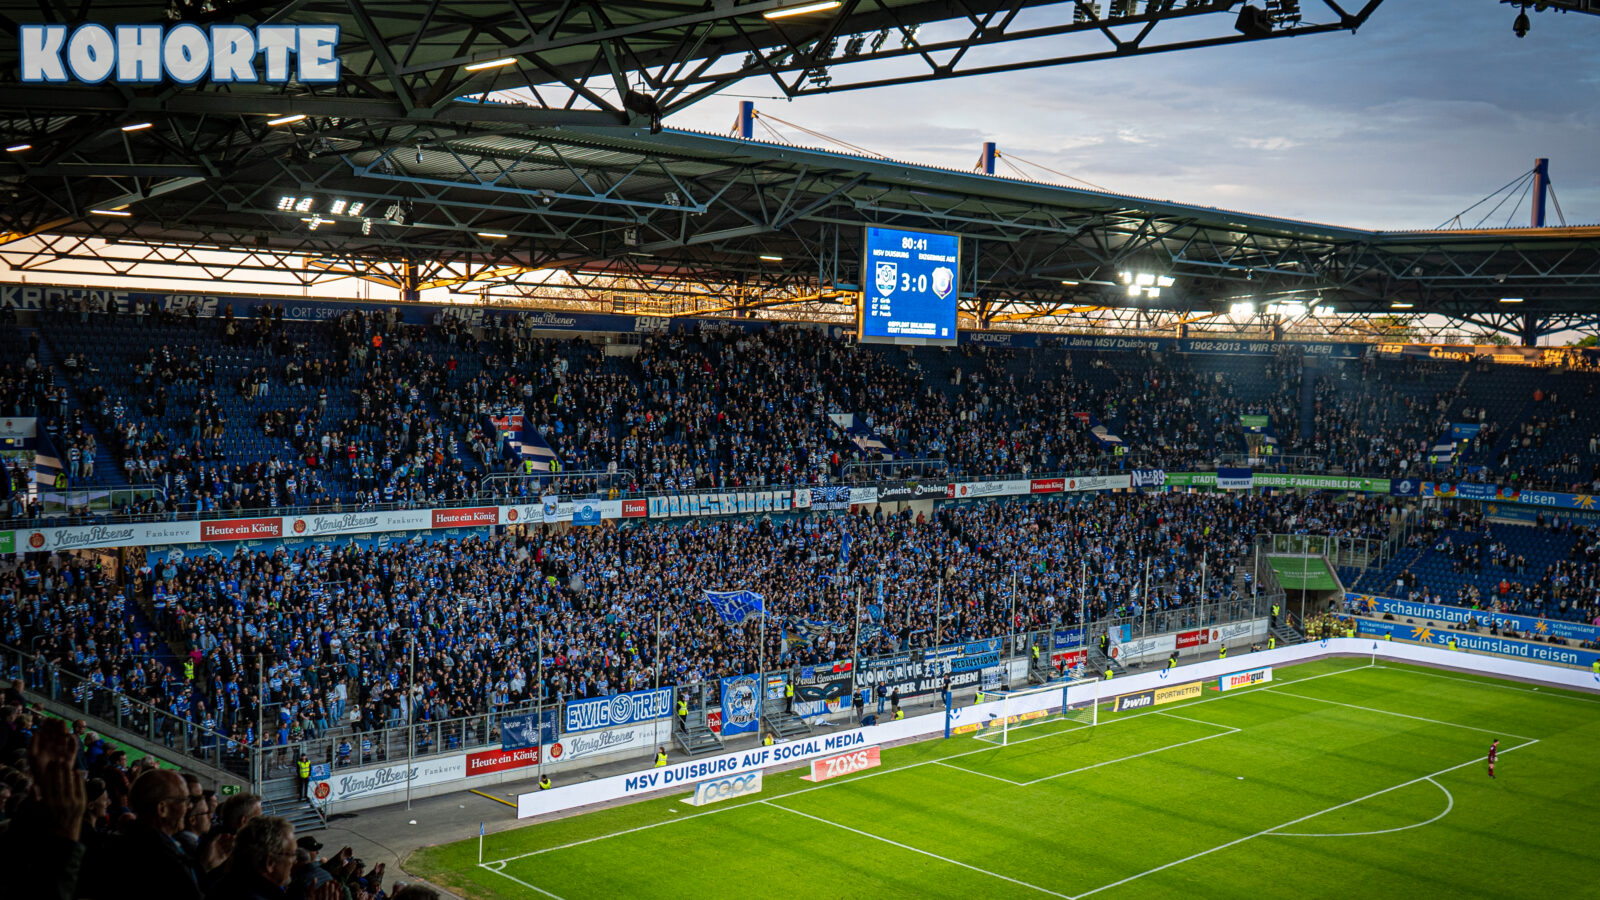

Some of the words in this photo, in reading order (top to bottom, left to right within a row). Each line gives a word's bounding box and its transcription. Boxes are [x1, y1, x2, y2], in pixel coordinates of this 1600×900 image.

[902, 237, 927, 251] 80:41
[901, 273, 927, 293] 3:0
[1, 286, 129, 313] KROHNE
[1070, 338, 1094, 347] Jahre
[1094, 338, 1117, 348] MSV
[1190, 341, 1242, 352] 1902-2013
[1249, 343, 1270, 353] WIR
[914, 481, 948, 496] Duisburg
[1520, 492, 1556, 505] eisen
[436, 513, 459, 525] Heute
[460, 512, 472, 522] ein
[474, 509, 496, 524] König
[626, 504, 645, 514] Heute
[206, 523, 234, 536] Heute
[236, 523, 250, 534] ein
[251, 520, 279, 536] König
[313, 515, 345, 532] König
[343, 513, 379, 528] Pilsener
[387, 516, 425, 525] Fankurve
[54, 529, 91, 549] König
[90, 526, 135, 544] Pilsener
[146, 529, 190, 539] Fankurve
[1383, 601, 1472, 625] schauinsland
[1438, 632, 1529, 658] schauinsland
[1532, 646, 1578, 664] reisen
[817, 671, 852, 684] Generation
[856, 662, 923, 686] KOHORTE
[1230, 670, 1264, 684] trinkgut
[919, 677, 944, 692] ALLE
[1122, 693, 1151, 708] bwin
[1155, 685, 1200, 701] SPORTWETTEN
[567, 698, 611, 731] EWIG
[631, 688, 672, 722] TREU
[708, 718, 721, 728] Heu
[569, 734, 600, 755] König
[598, 729, 635, 747] Pilsener
[471, 752, 497, 768] Heute
[498, 752, 512, 764] ein
[513, 749, 538, 764] König
[625, 772, 660, 793] MSV
[664, 756, 738, 783] DUISBURG
[742, 749, 770, 769] AUF
[773, 738, 822, 761] SOCIAL
[824, 731, 866, 750] MEDIA
[825, 750, 869, 778] ZOXS
[339, 774, 376, 795] König
[374, 766, 420, 786] Pilsener
[424, 764, 461, 776] Fankurve
